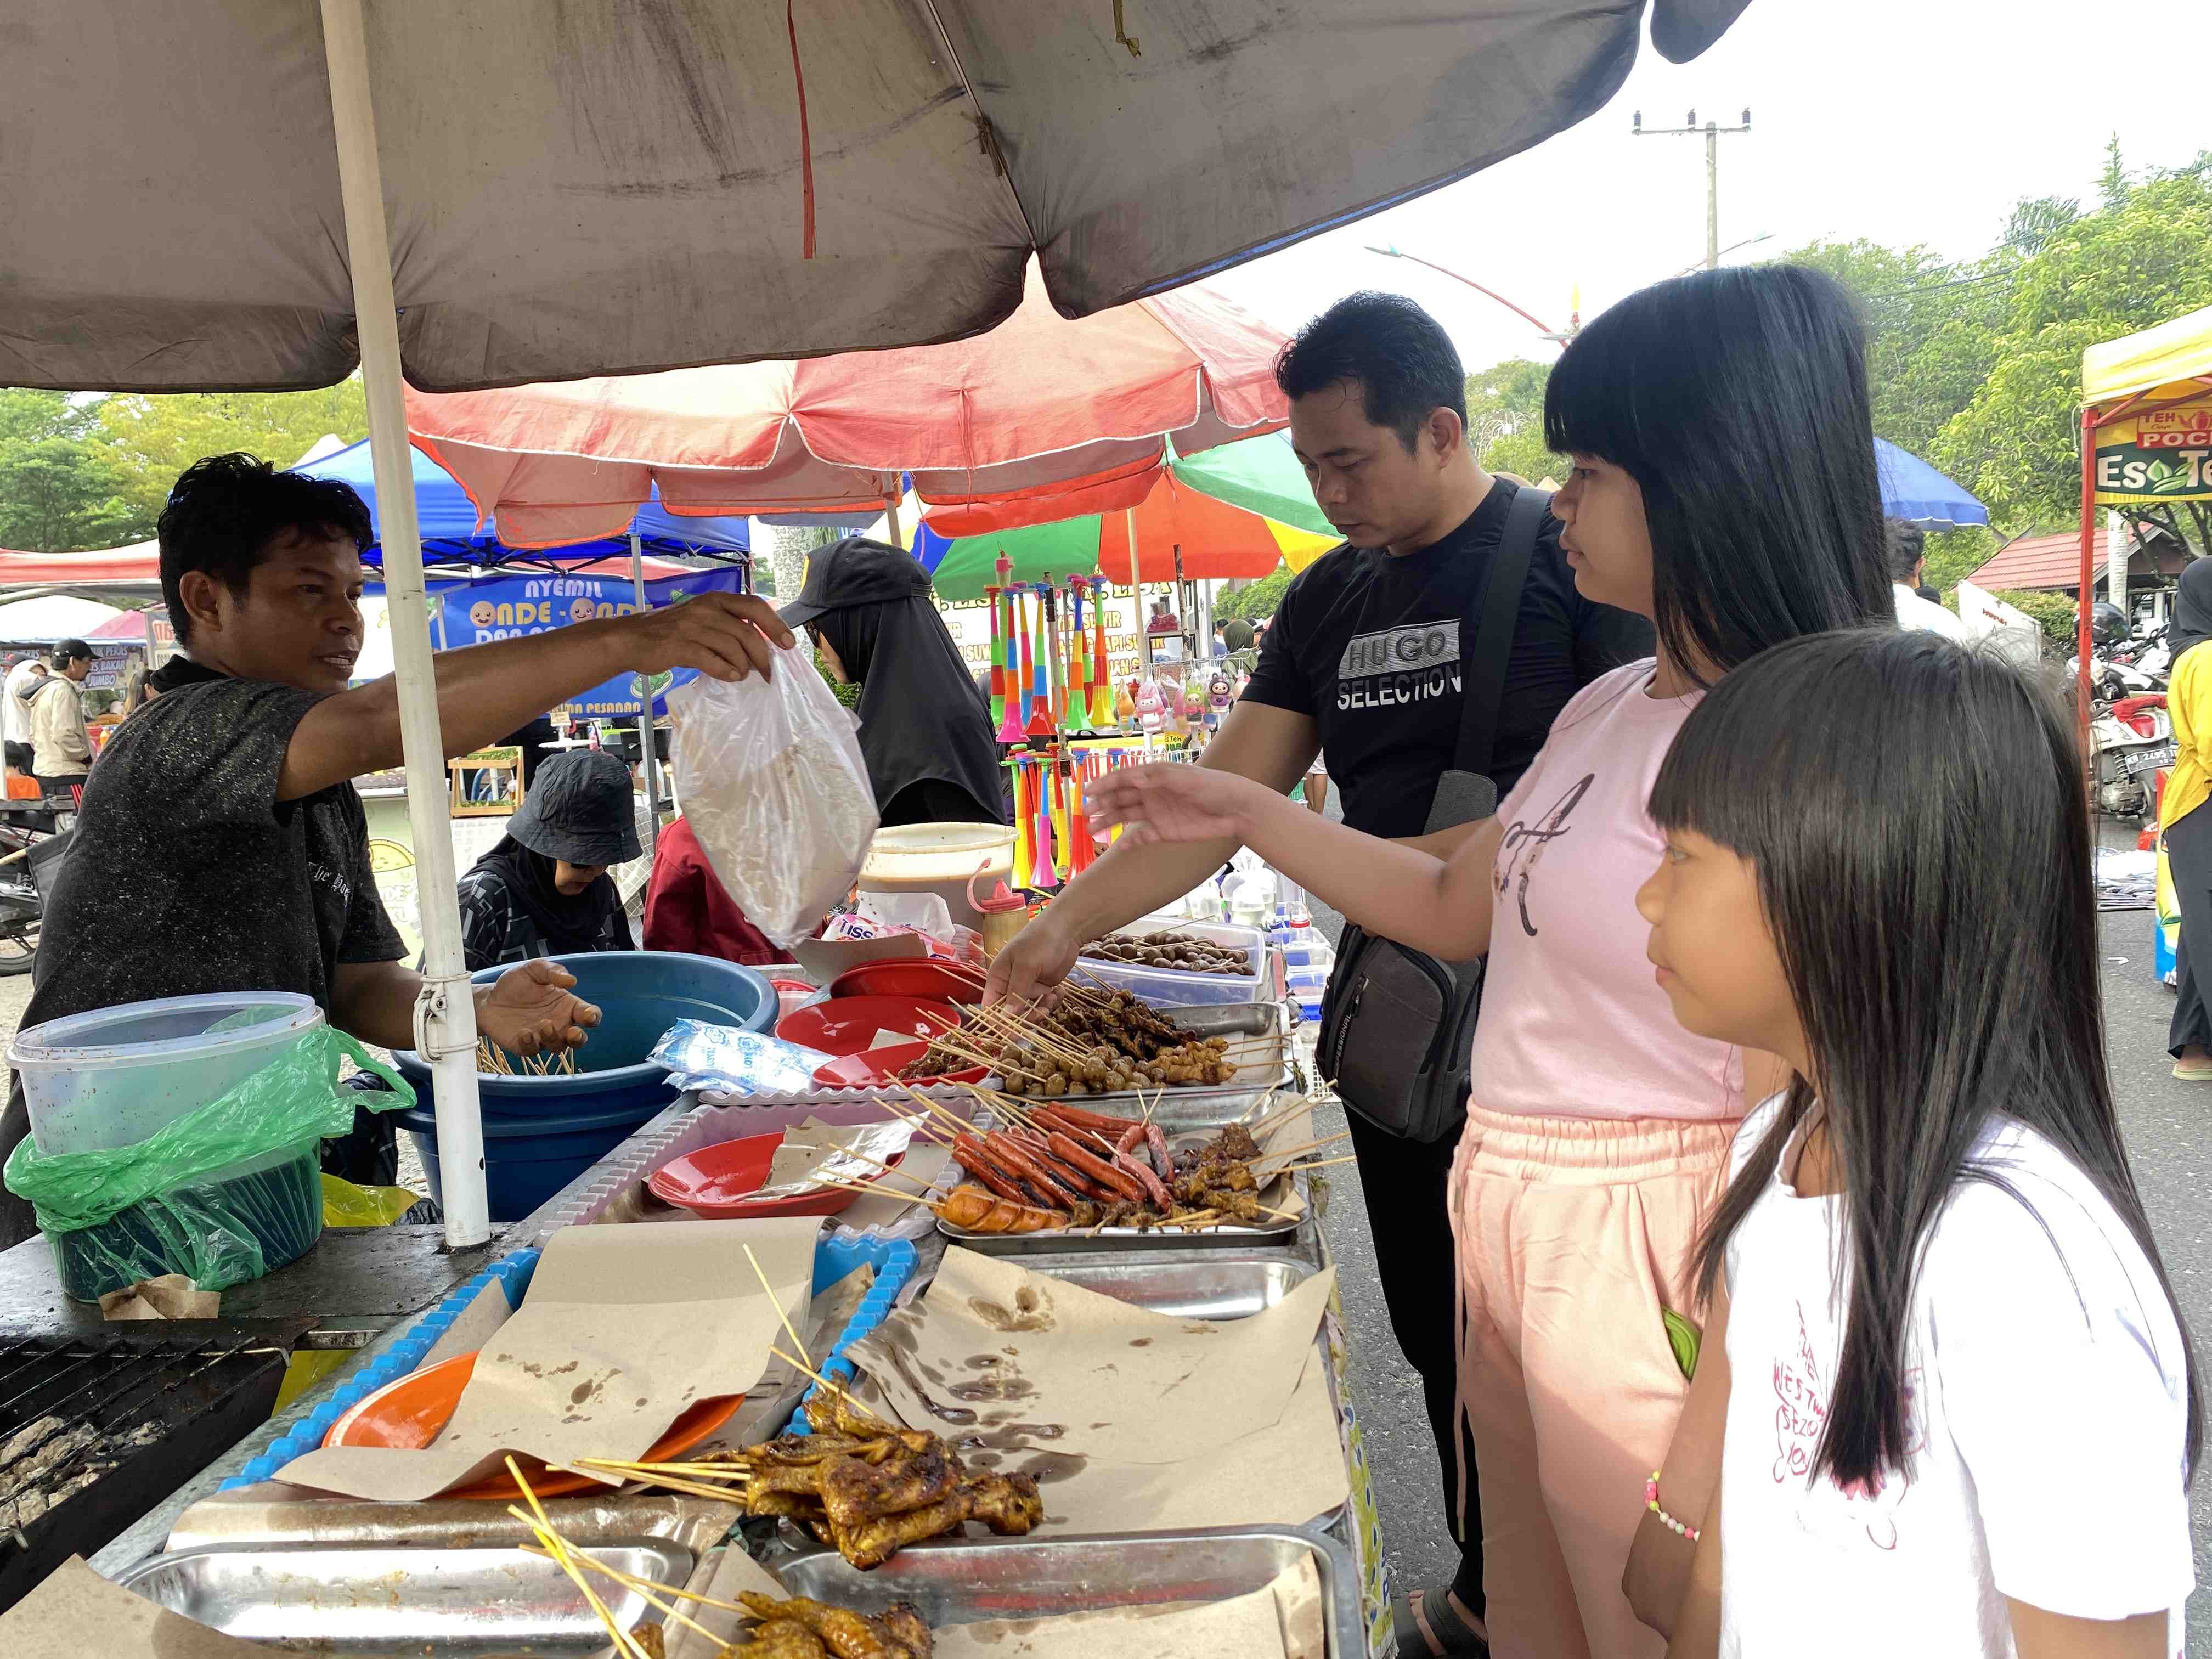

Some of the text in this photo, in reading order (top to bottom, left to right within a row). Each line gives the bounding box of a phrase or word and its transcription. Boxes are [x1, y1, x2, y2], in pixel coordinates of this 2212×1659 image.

[2143, 412, 2176, 422] TEH
[2098, 455, 2147, 488] Es
[525, 579, 602, 599] NYEMIL
[1347, 630, 1446, 670] HUGO
[100, 659, 126, 671] BAKAR
[88, 673, 116, 686] JUMBO
[1337, 663, 1462, 710] SELECTION
